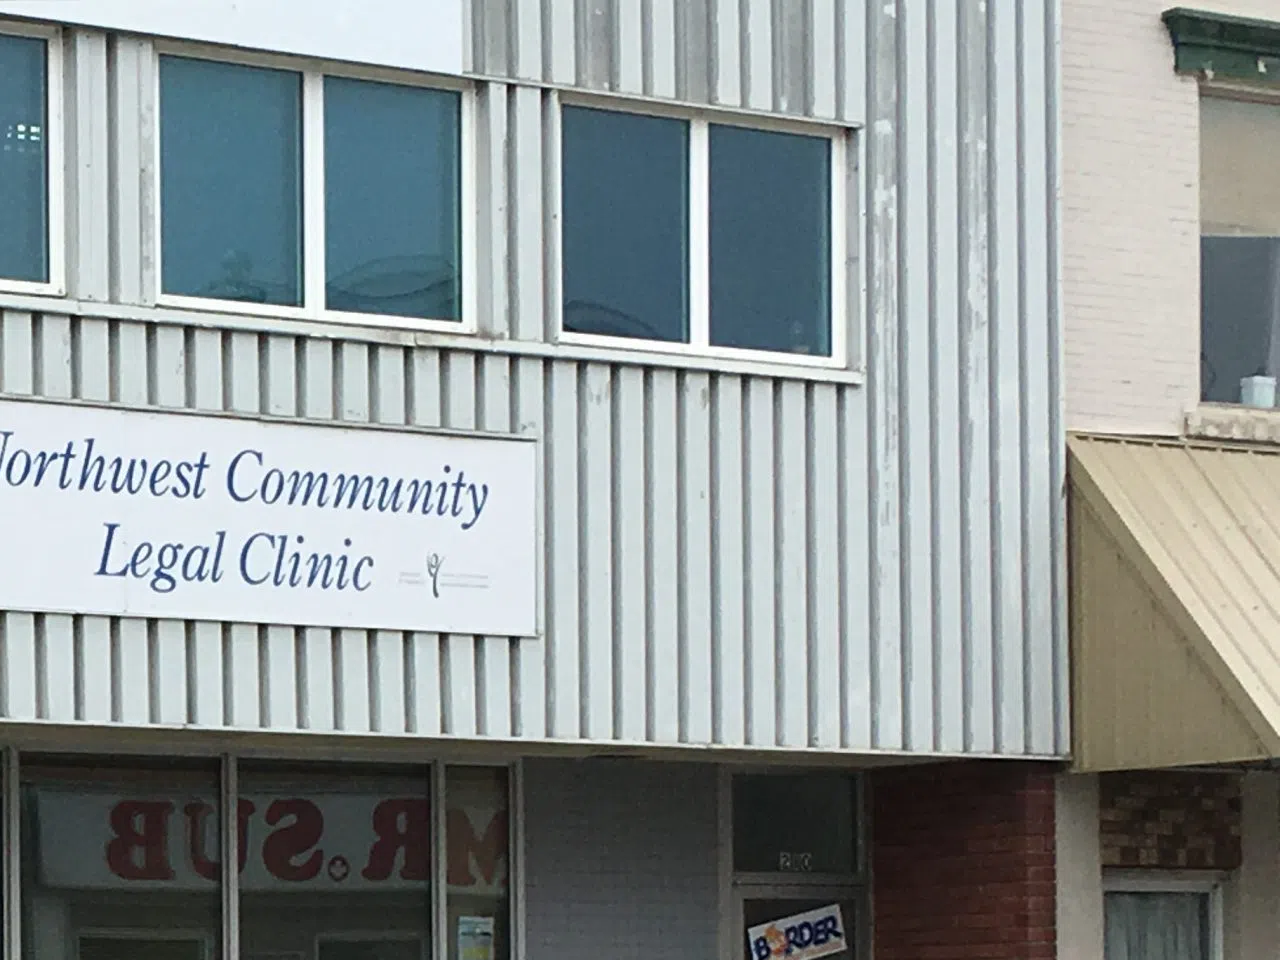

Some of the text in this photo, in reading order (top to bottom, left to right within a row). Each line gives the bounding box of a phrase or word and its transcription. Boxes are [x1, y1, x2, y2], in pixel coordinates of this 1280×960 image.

[226, 448, 489, 530] Community
[94, 523, 375, 592] Legal Clinic
